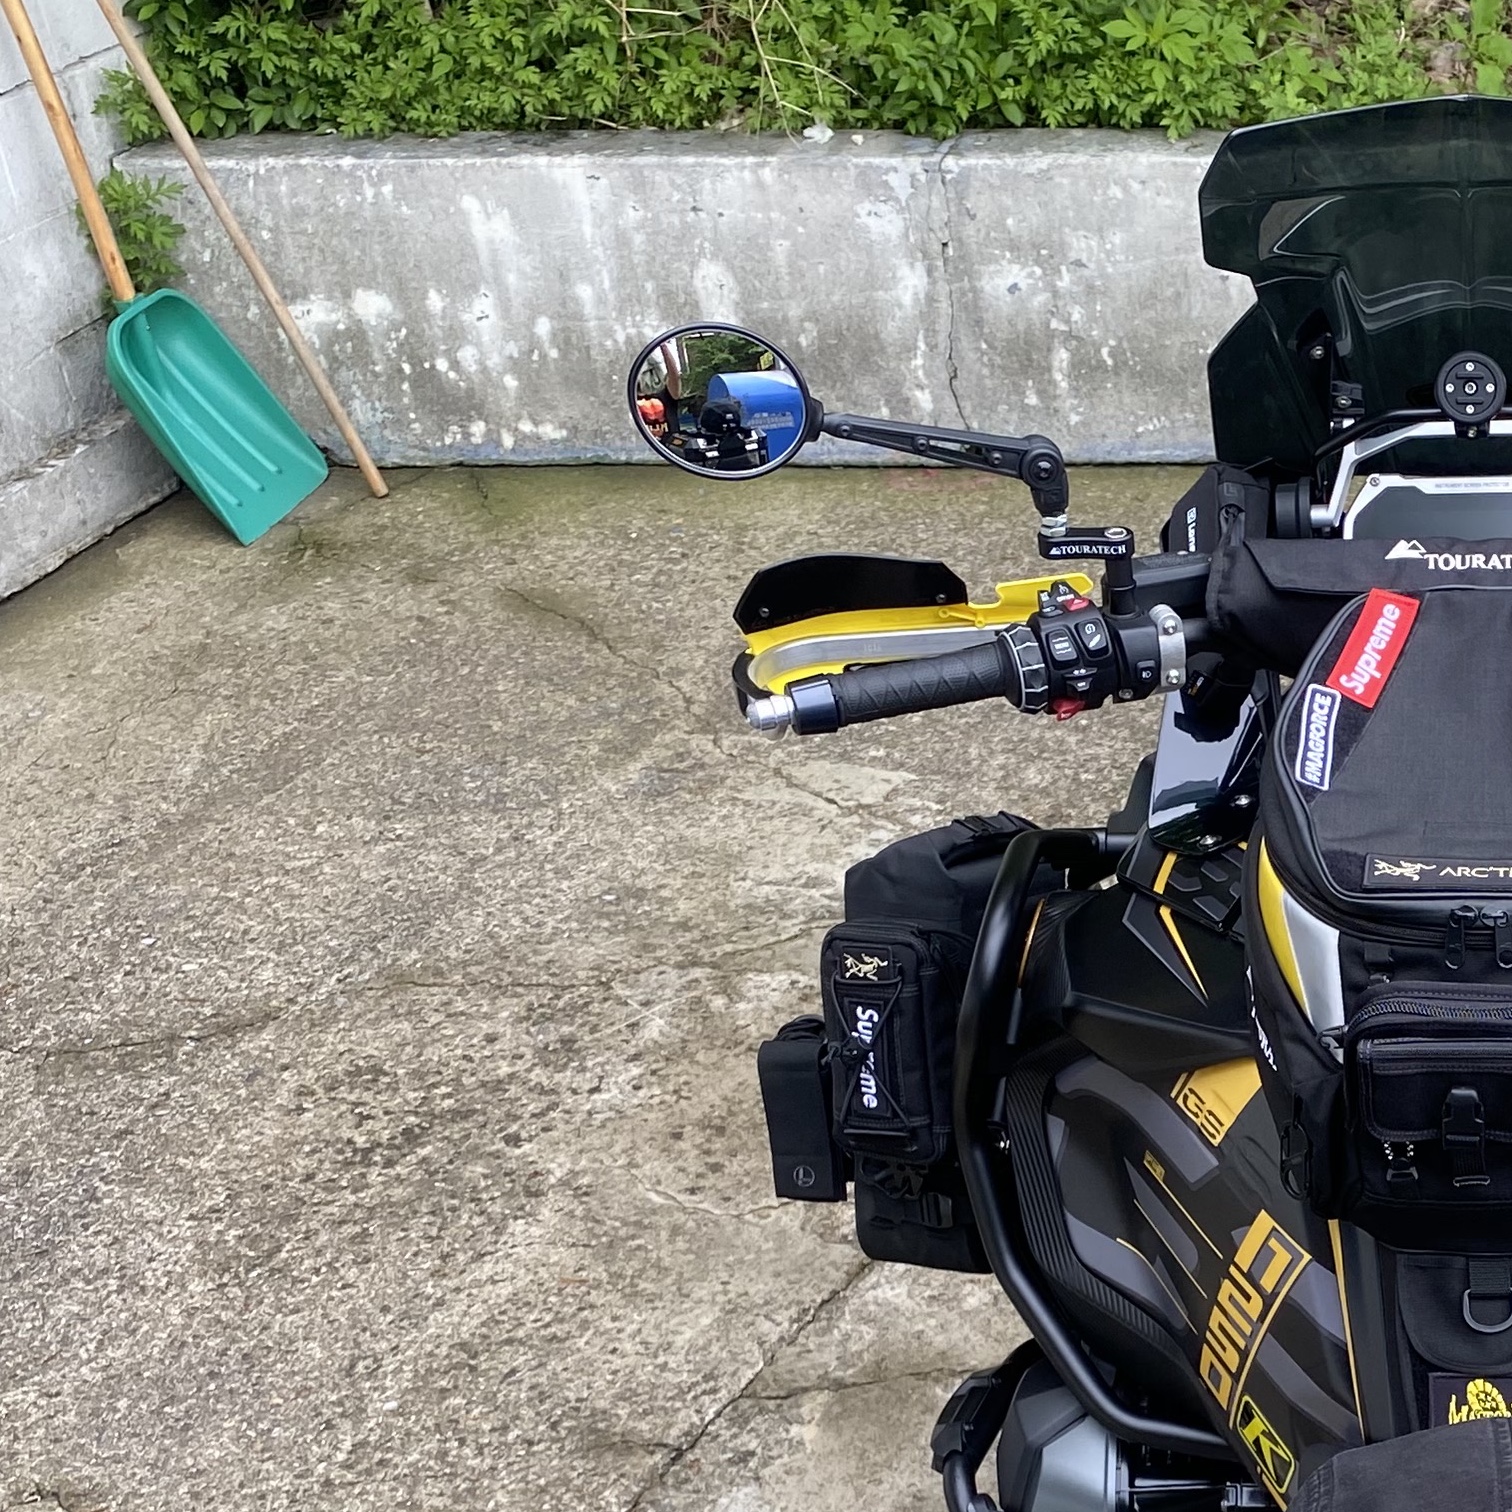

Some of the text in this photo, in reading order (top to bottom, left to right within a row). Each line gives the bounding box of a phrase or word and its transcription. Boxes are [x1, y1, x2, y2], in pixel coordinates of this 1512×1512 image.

[1060, 544, 1127, 555] TOURATECH
[1338, 603, 1401, 695] Supreme
[1304, 692, 1333, 784] #MAGFORCE
[1182, 1087, 1225, 1140] GS
